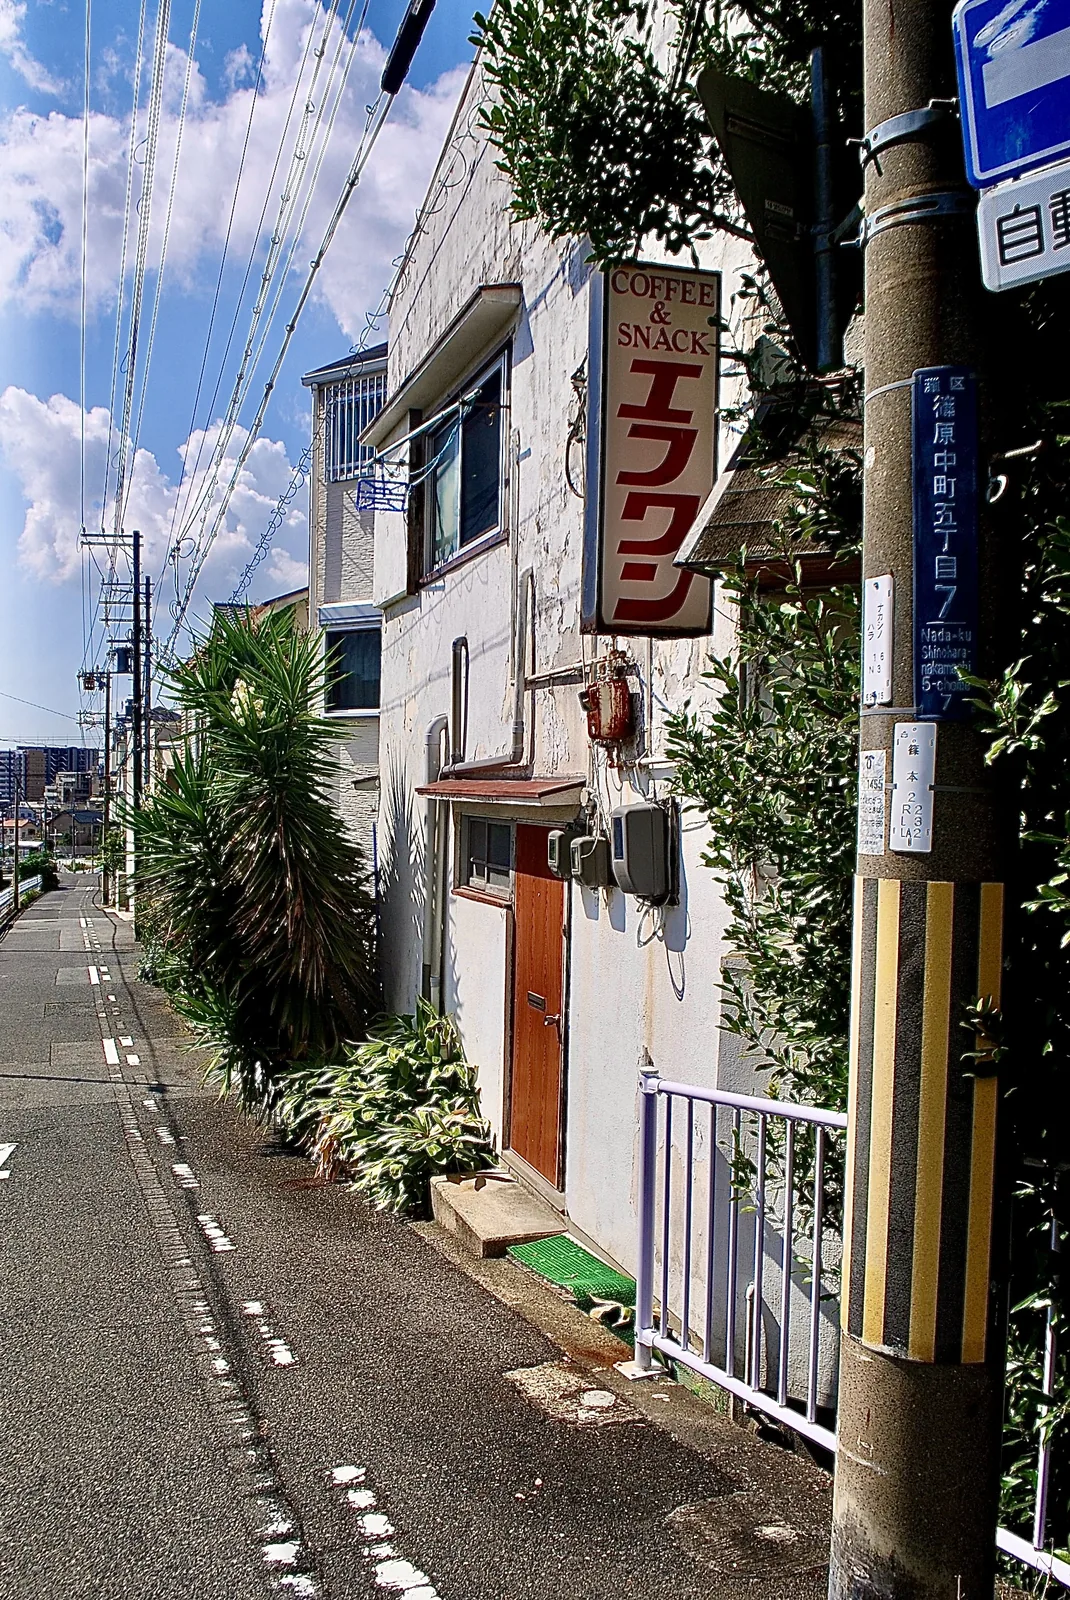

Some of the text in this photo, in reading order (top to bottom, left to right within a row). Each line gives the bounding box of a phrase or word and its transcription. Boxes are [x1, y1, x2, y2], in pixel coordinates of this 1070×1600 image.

[611, 269, 715, 308] COFFEE
[649, 301, 672, 326] &
[617, 322, 711, 356] SNACK
[920, 627, 972, 643] Nada-ku
[940, 692, 952, 712] 7
[907, 792, 916, 803] 2
